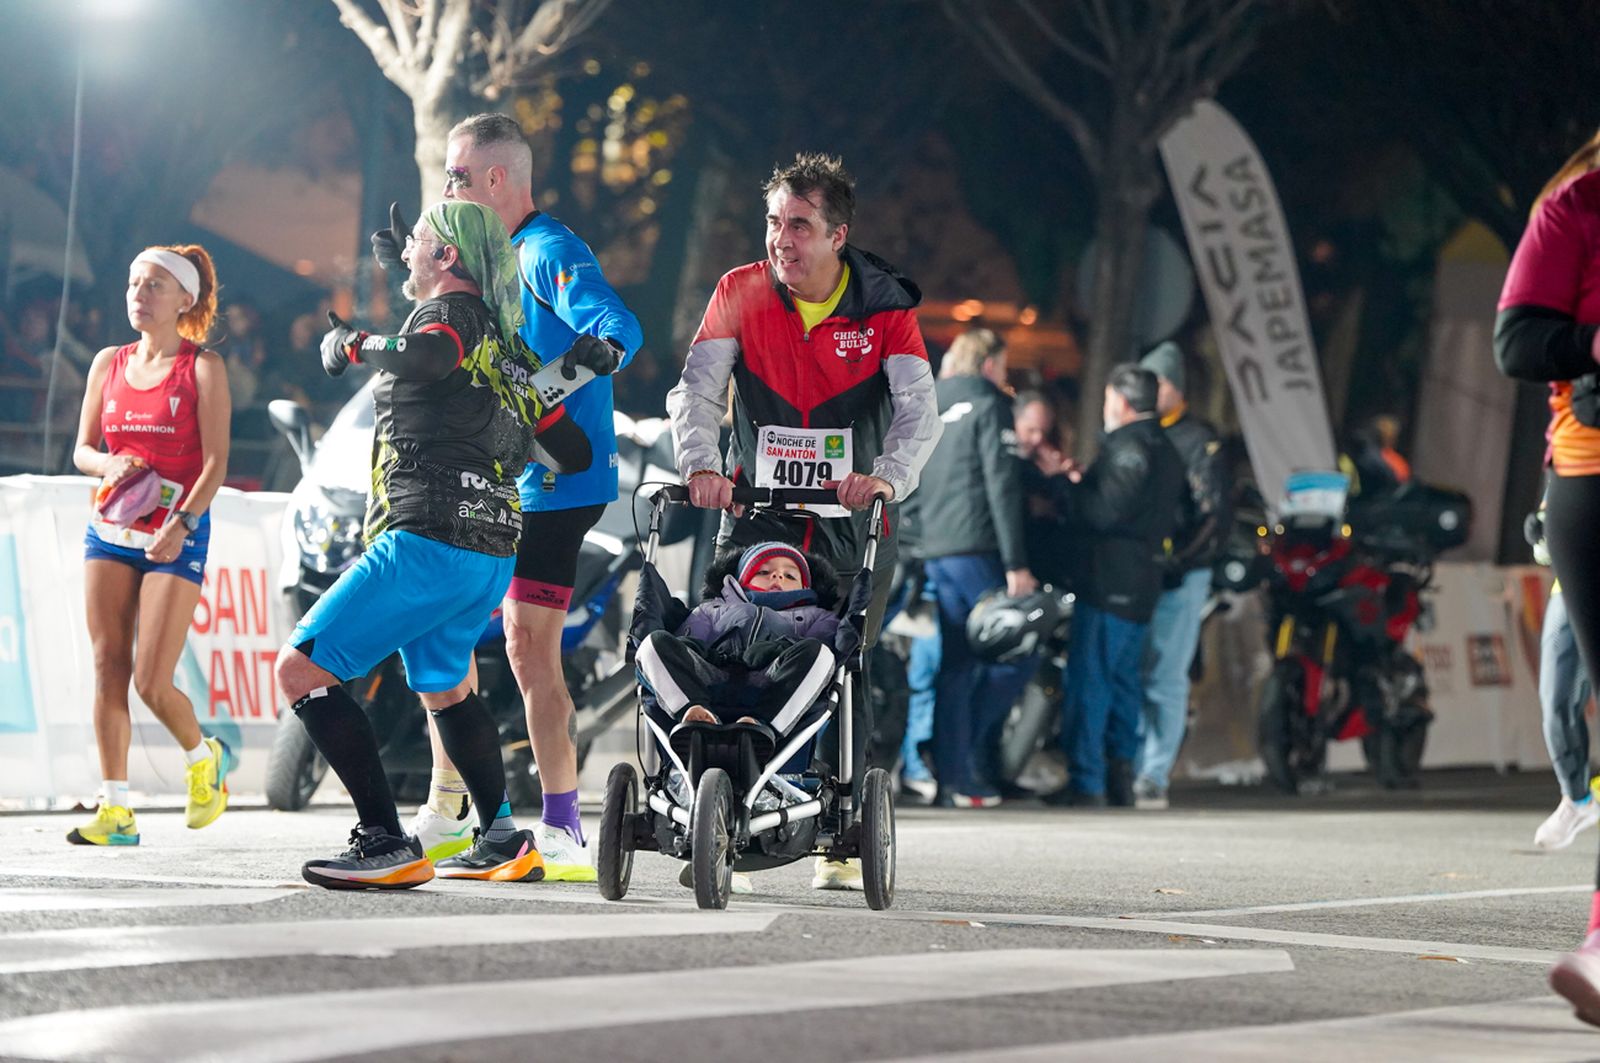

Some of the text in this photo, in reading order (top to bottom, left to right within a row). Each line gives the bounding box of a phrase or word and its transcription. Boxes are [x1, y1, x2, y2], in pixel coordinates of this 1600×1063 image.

[1221, 155, 1314, 391] JAPEMASA
[1189, 163, 1269, 405] DACIA
[833, 327, 874, 340] CHICAO
[121, 424, 176, 434] MARATHON
[766, 446, 783, 457] SAN
[784, 447, 817, 459] ANTÓN
[775, 437, 803, 448] NOCHE
[804, 439, 817, 449] DE
[773, 460, 832, 487] 4079
[192, 566, 268, 635] SAN
